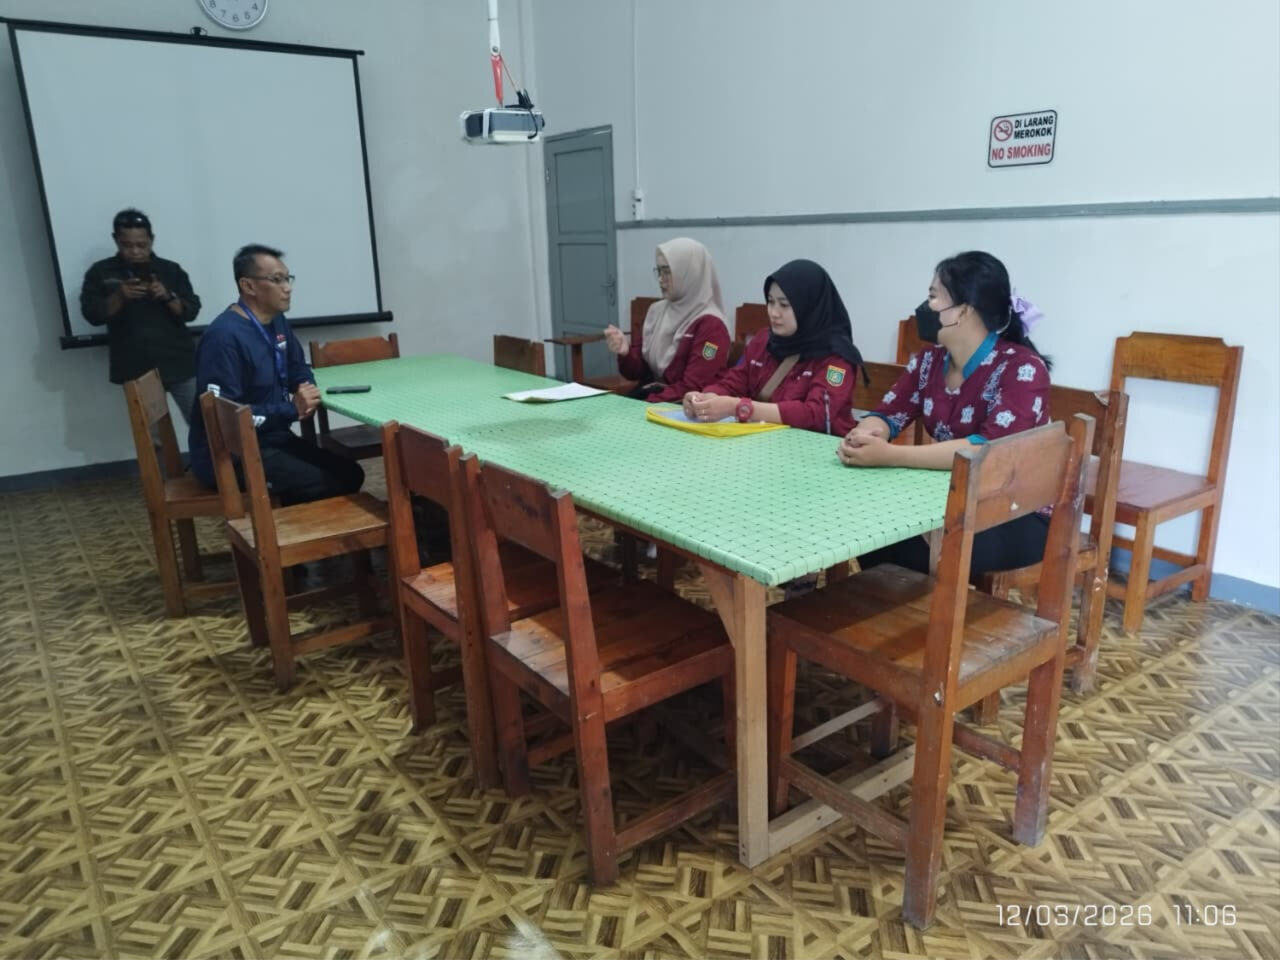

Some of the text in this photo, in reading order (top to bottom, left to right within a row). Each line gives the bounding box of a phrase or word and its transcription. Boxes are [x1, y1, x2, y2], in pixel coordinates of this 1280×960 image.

[252, 3, 258, 11] 4
[221, 9, 226, 17] 7
[232, 14, 239, 22] 6
[1014, 115, 1054, 128] DI LARANG
[1014, 126, 1053, 139] MEROKOK
[991, 143, 1051, 160] NO SMOKING
